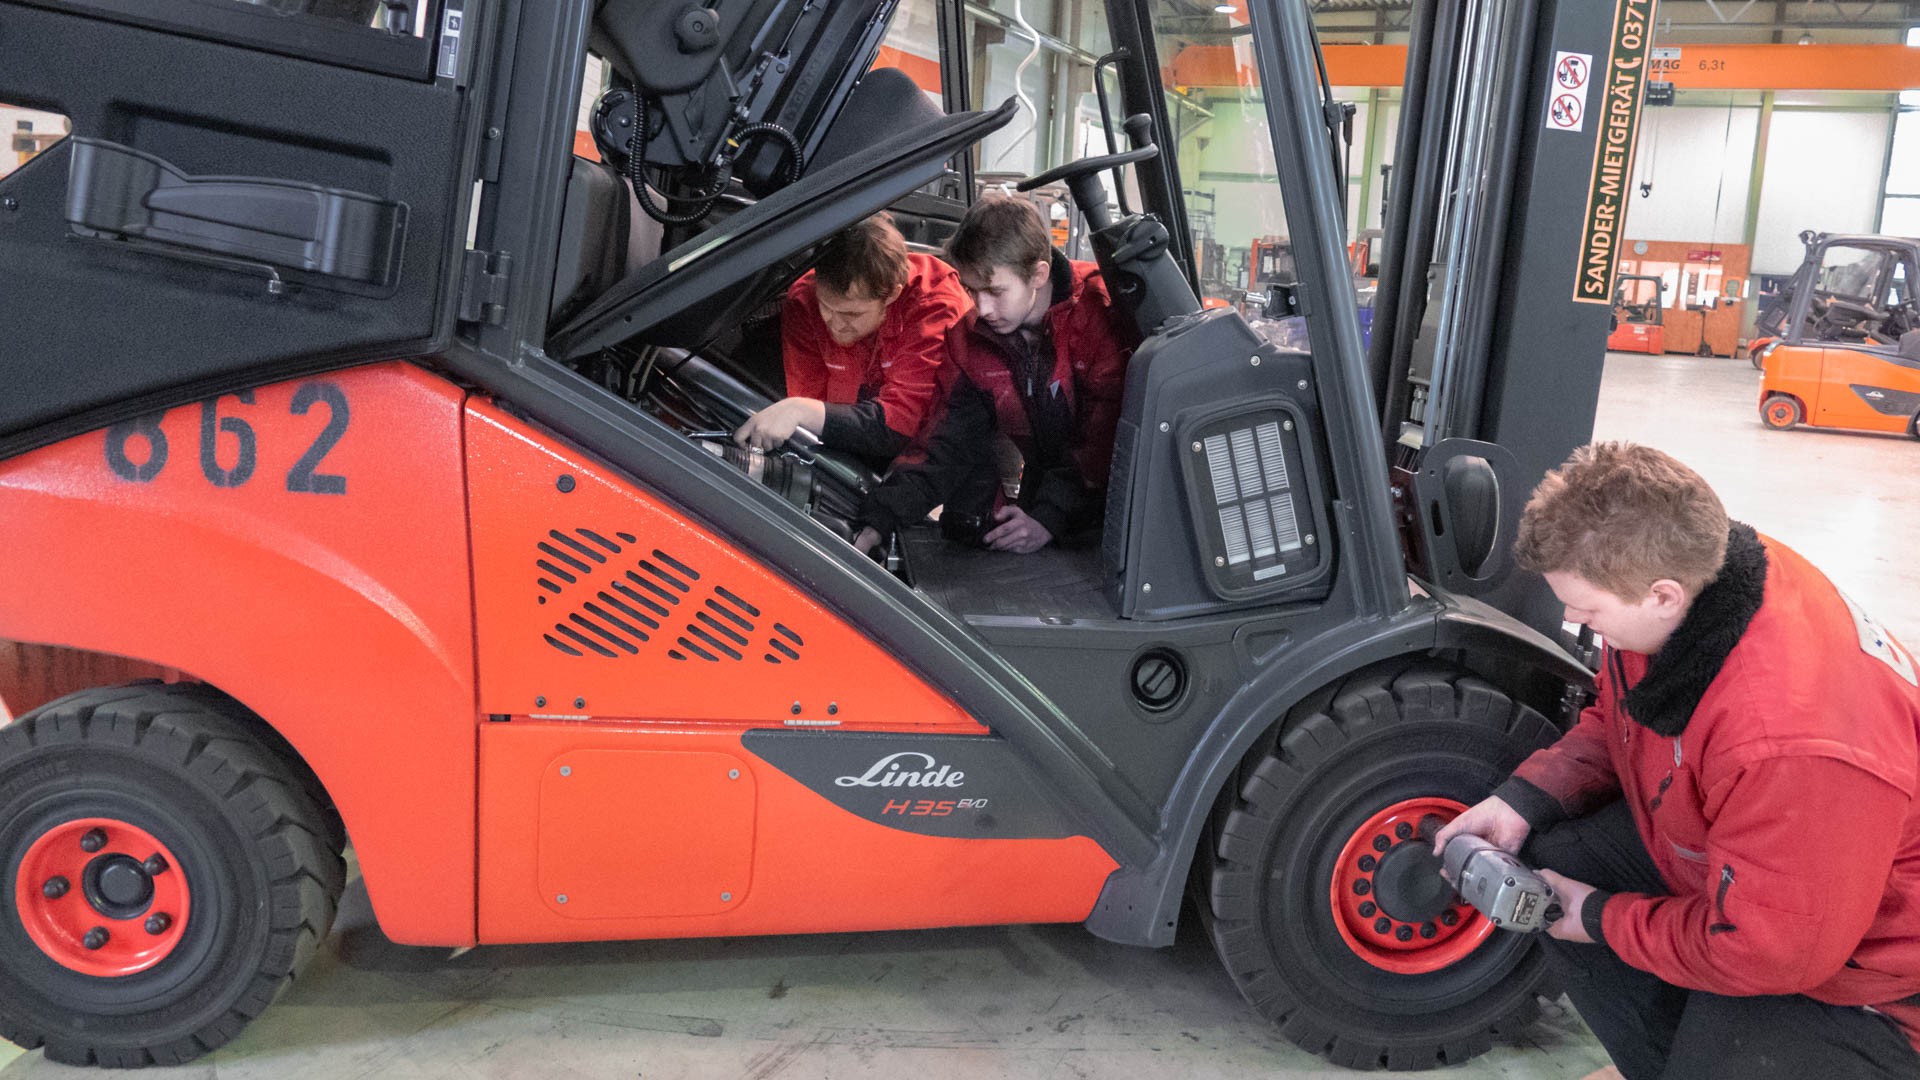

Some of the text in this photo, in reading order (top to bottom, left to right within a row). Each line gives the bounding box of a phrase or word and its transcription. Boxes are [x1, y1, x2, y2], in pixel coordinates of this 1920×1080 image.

[1585, 73, 1635, 295] SANDER-MIETGERÄT
[834, 752, 965, 788] Linde
[882, 799, 911, 815] H
[910, 800, 956, 816] 35
